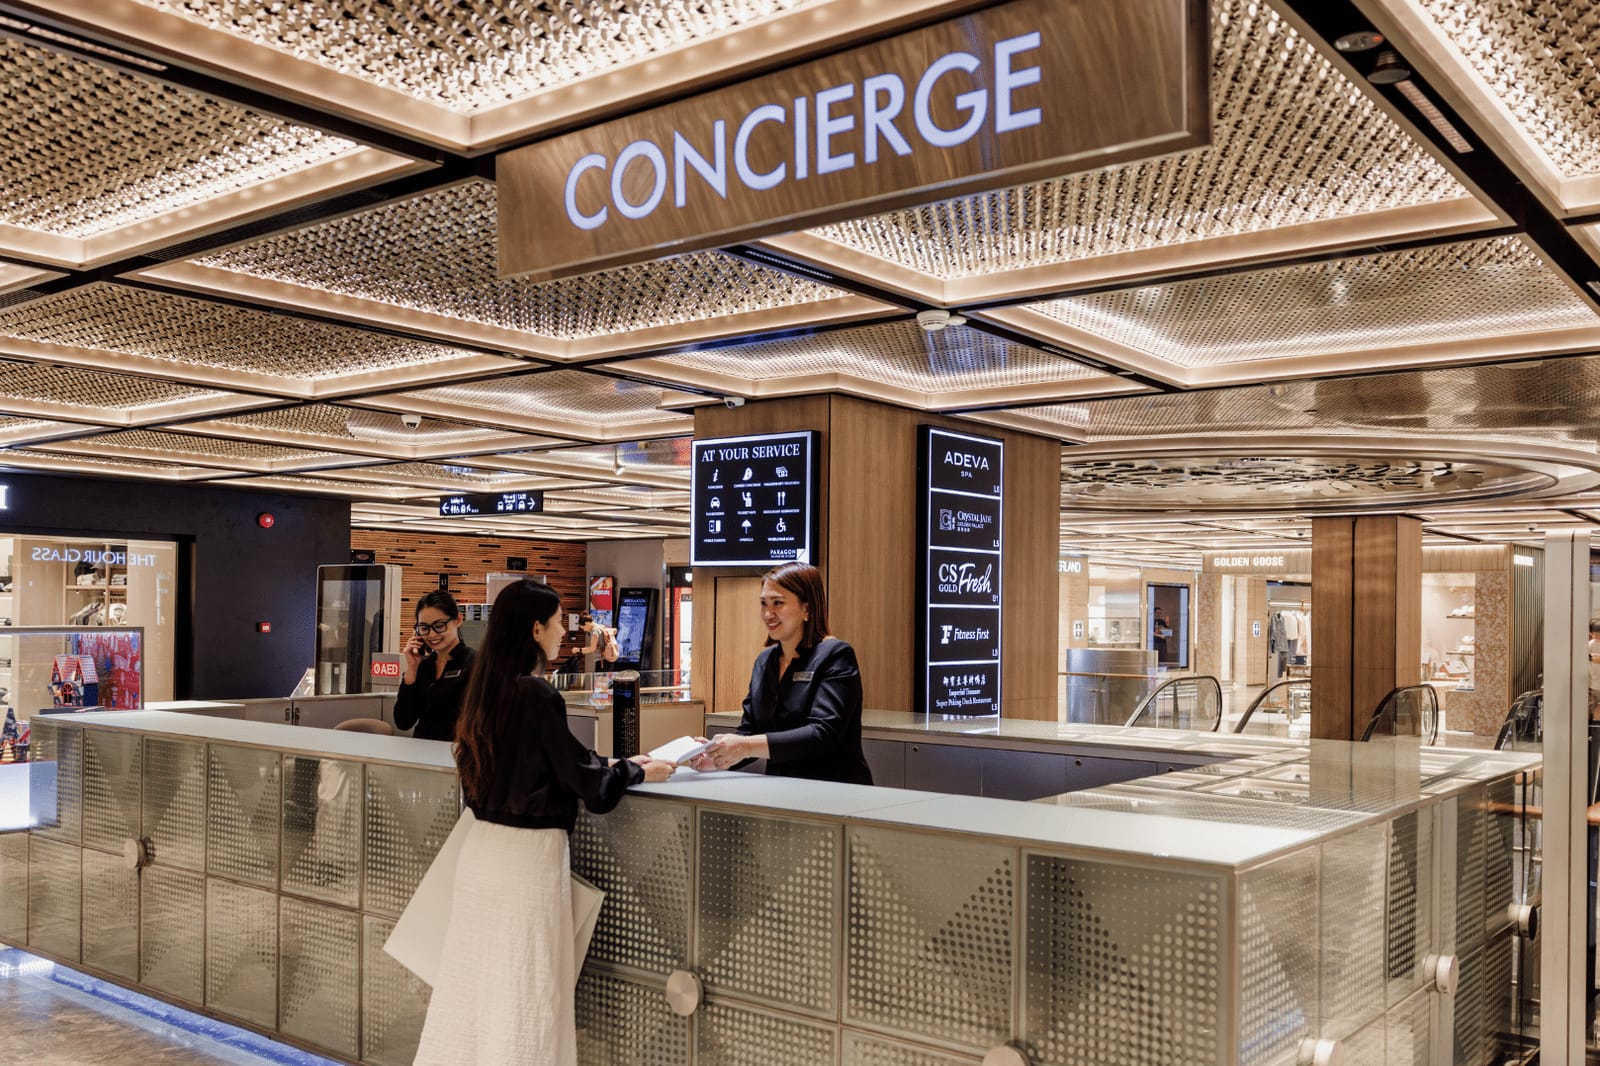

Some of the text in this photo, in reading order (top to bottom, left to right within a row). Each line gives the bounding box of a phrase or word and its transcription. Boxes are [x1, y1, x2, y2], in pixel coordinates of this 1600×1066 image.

[564, 32, 1042, 230] CONCIERGE
[702, 443, 800, 462] AT YOUR SERVICE
[944, 451, 989, 470] ADEVA
[1213, 555, 1284, 567] GOLDEN GOOSE
[938, 562, 993, 595] CS Fresh
[938, 583, 958, 593] GOLD
[954, 628, 976, 641] Fitness
[976, 628, 990, 641] First
[381, 664, 398, 675] AED
